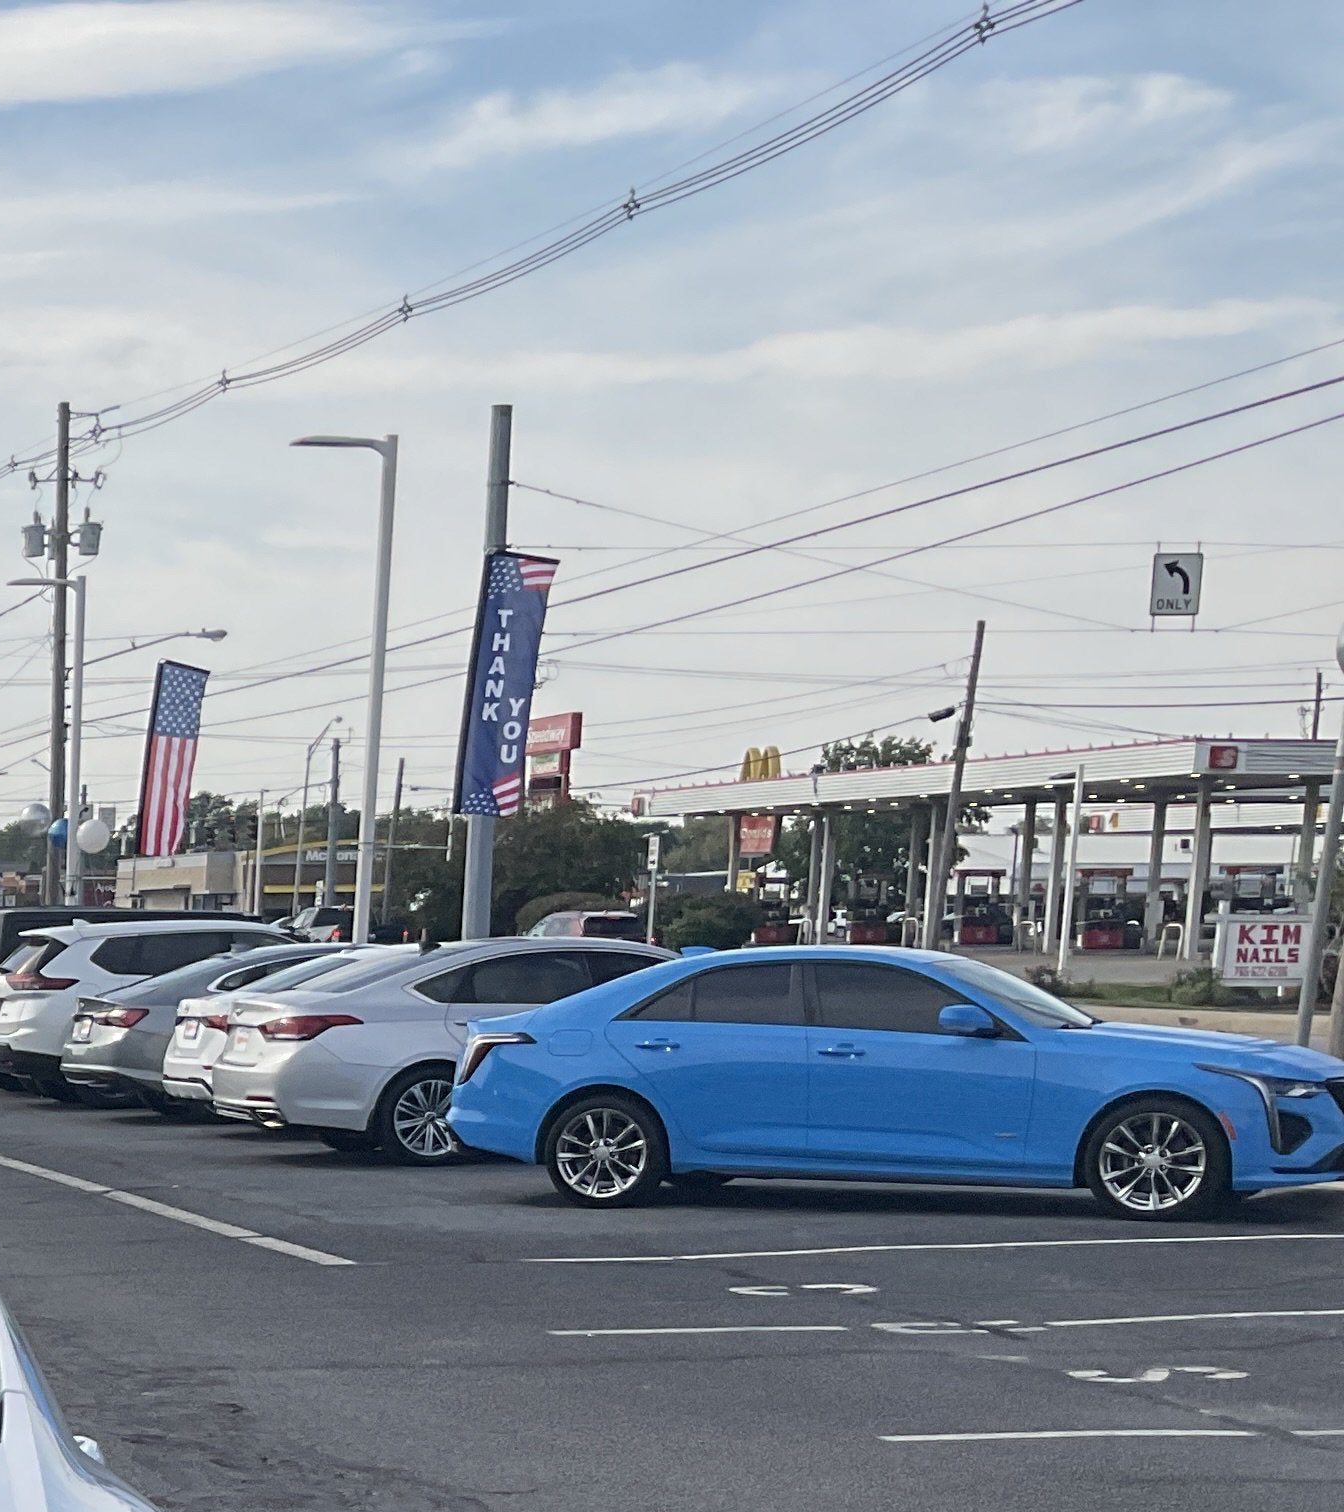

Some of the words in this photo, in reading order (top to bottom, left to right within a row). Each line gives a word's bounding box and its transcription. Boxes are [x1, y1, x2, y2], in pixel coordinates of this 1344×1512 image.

[1156, 598, 1192, 610] ONLY
[481, 609, 514, 722] THANK
[500, 697, 526, 764] YOU
[1238, 924, 1302, 945] KIM
[1236, 947, 1300, 963] NAILS
